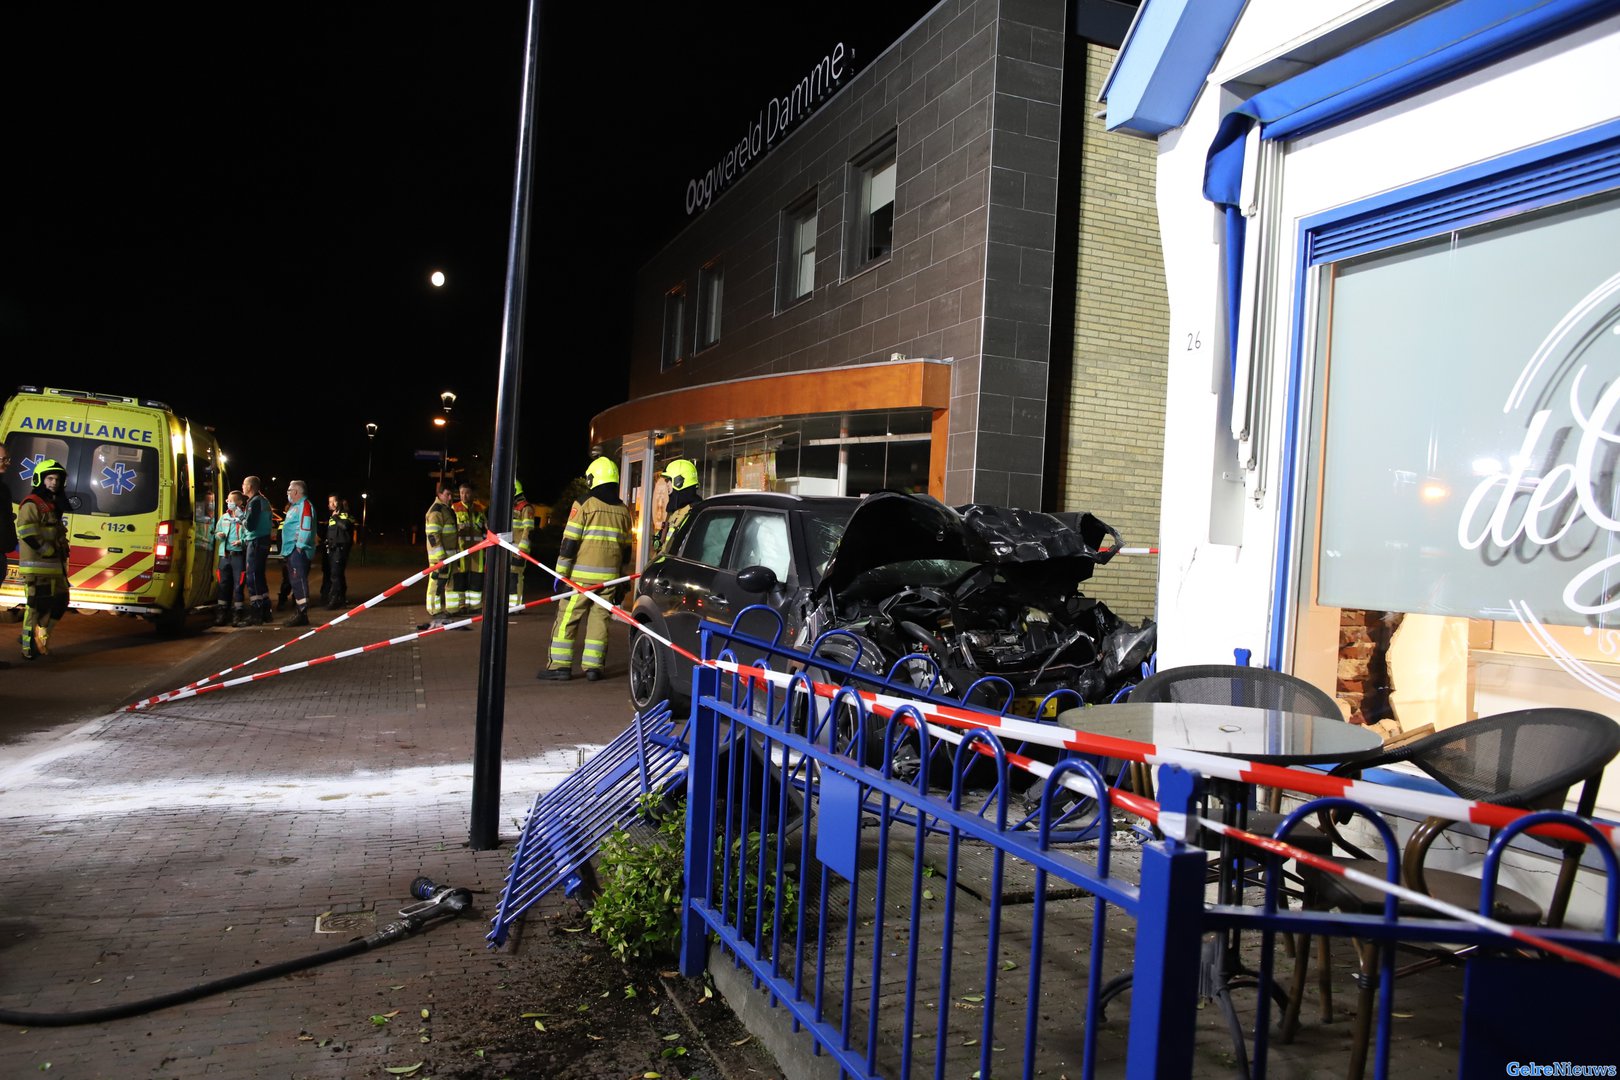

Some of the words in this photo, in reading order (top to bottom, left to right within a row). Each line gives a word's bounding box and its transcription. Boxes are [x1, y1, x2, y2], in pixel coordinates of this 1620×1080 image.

[685, 109, 763, 215] Oogwereld
[766, 41, 845, 144] Damme
[1187, 330, 1202, 351] 26
[20, 416, 153, 443] AMBULANCE
